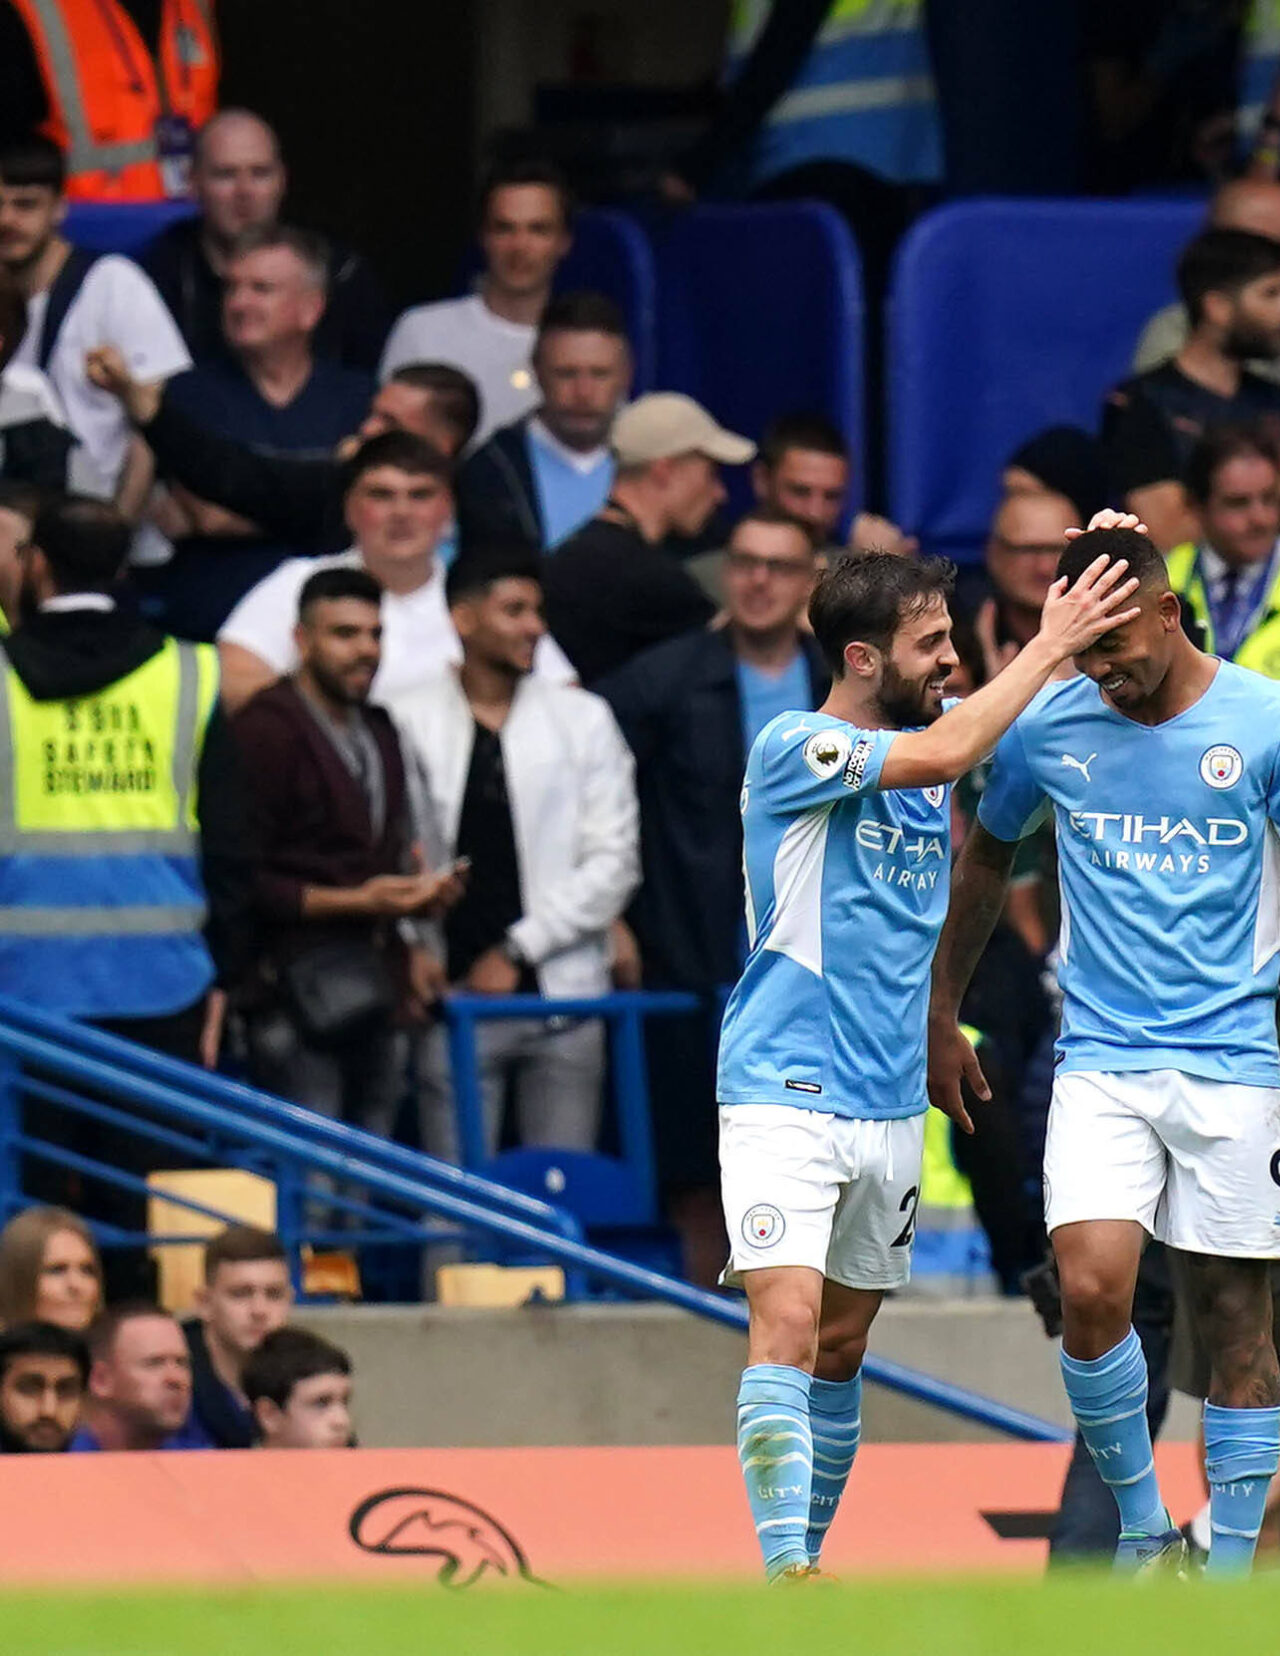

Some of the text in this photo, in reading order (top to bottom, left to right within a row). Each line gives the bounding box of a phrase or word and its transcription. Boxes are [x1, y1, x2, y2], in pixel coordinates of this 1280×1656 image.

[855, 819, 945, 863] ETHA
[1070, 811, 1248, 846] ETIHAD
[873, 861, 938, 891] AIRAY
[1091, 850, 1211, 874] AIRWAYS
[757, 1483, 804, 1499] CITY
